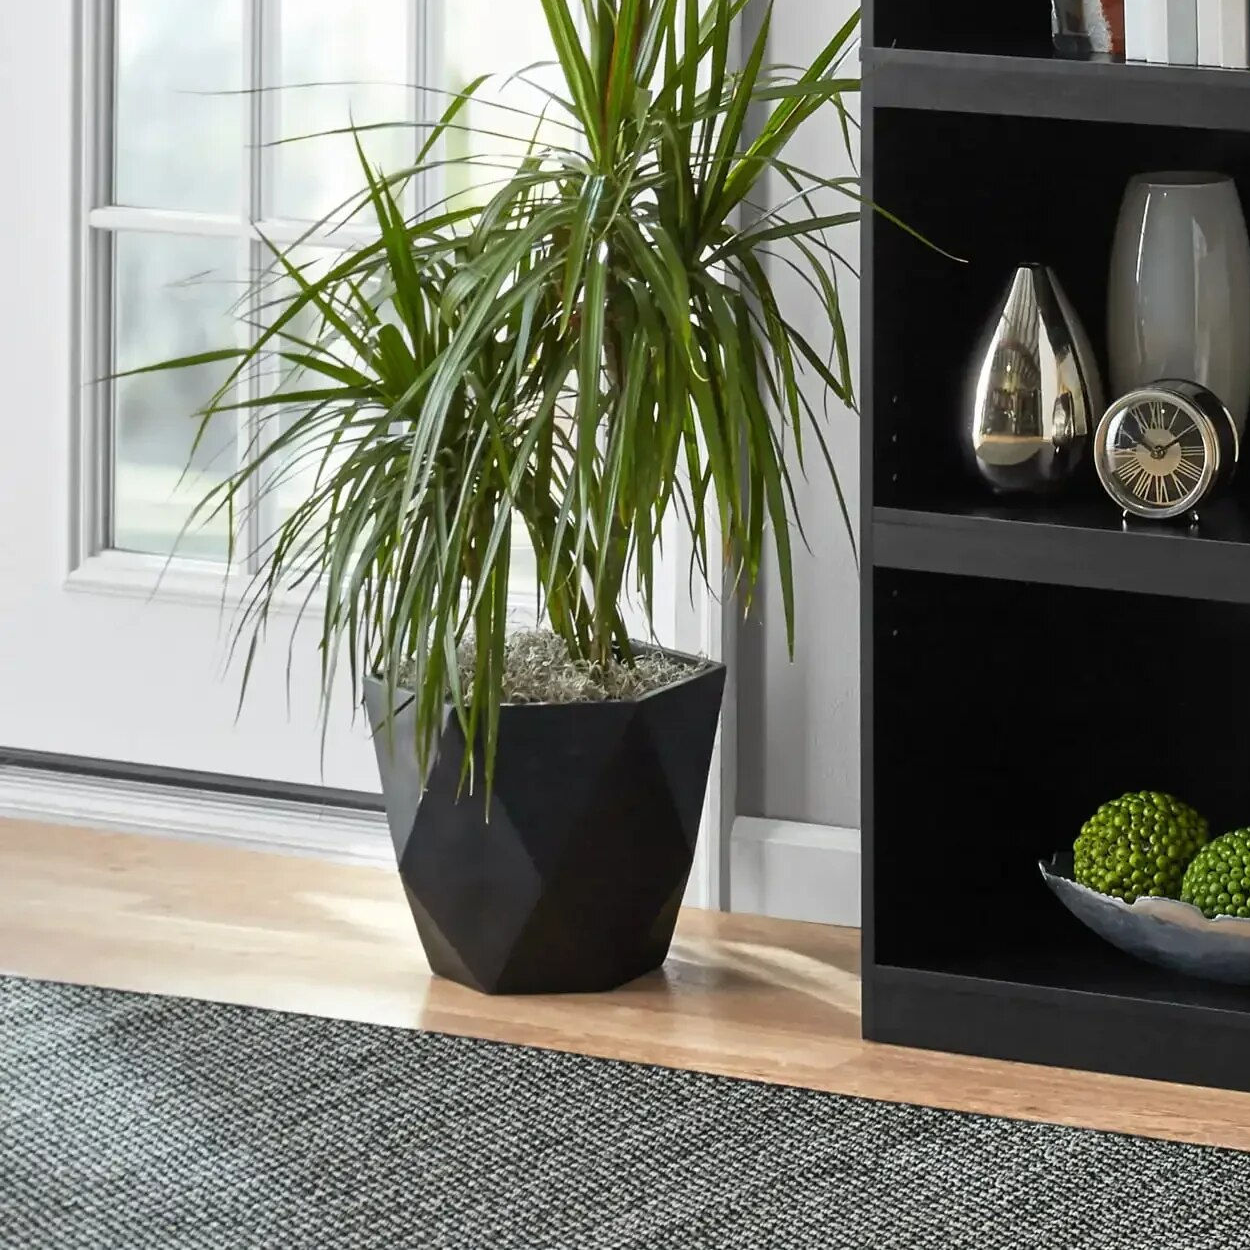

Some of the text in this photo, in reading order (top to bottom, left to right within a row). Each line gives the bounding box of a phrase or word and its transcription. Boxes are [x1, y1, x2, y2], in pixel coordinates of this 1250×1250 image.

[1181, 446, 1205, 456] III
[1133, 472, 1153, 500] VII
[1155, 475, 1169, 503] VI
[1172, 472, 1189, 498] V
